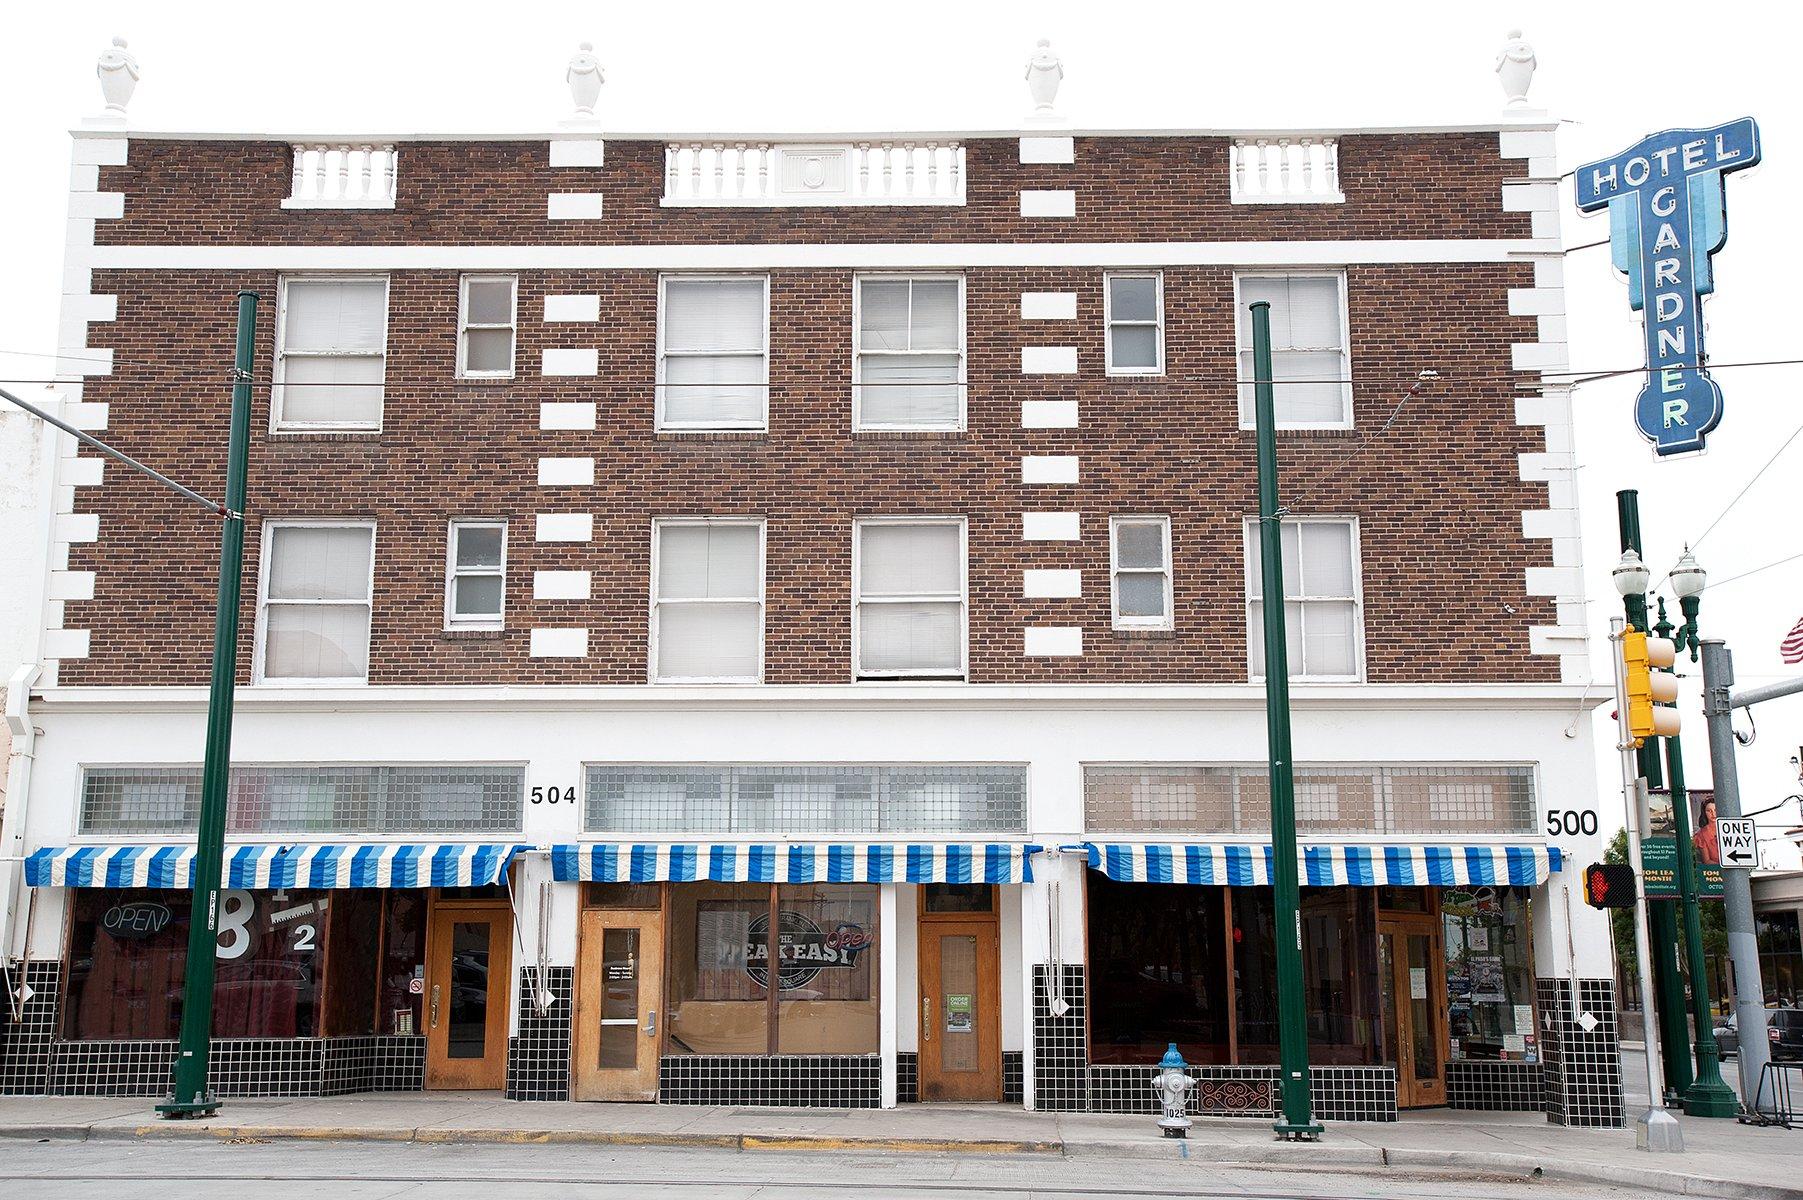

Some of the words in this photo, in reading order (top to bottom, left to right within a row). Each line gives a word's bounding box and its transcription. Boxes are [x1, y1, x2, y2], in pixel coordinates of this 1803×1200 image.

[1593, 133, 1740, 196] HOTEL
[1651, 186, 1690, 429] GARDNER
[531, 786, 576, 804] 504
[1547, 810, 1598, 836] 500
[1722, 822, 1751, 834] ONE
[1722, 836, 1752, 848] WAY
[104, 906, 165, 932] OPEN
[293, 924, 316, 950] 2
[826, 932, 874, 949] Open
[1166, 1109, 1185, 1119] 1025
